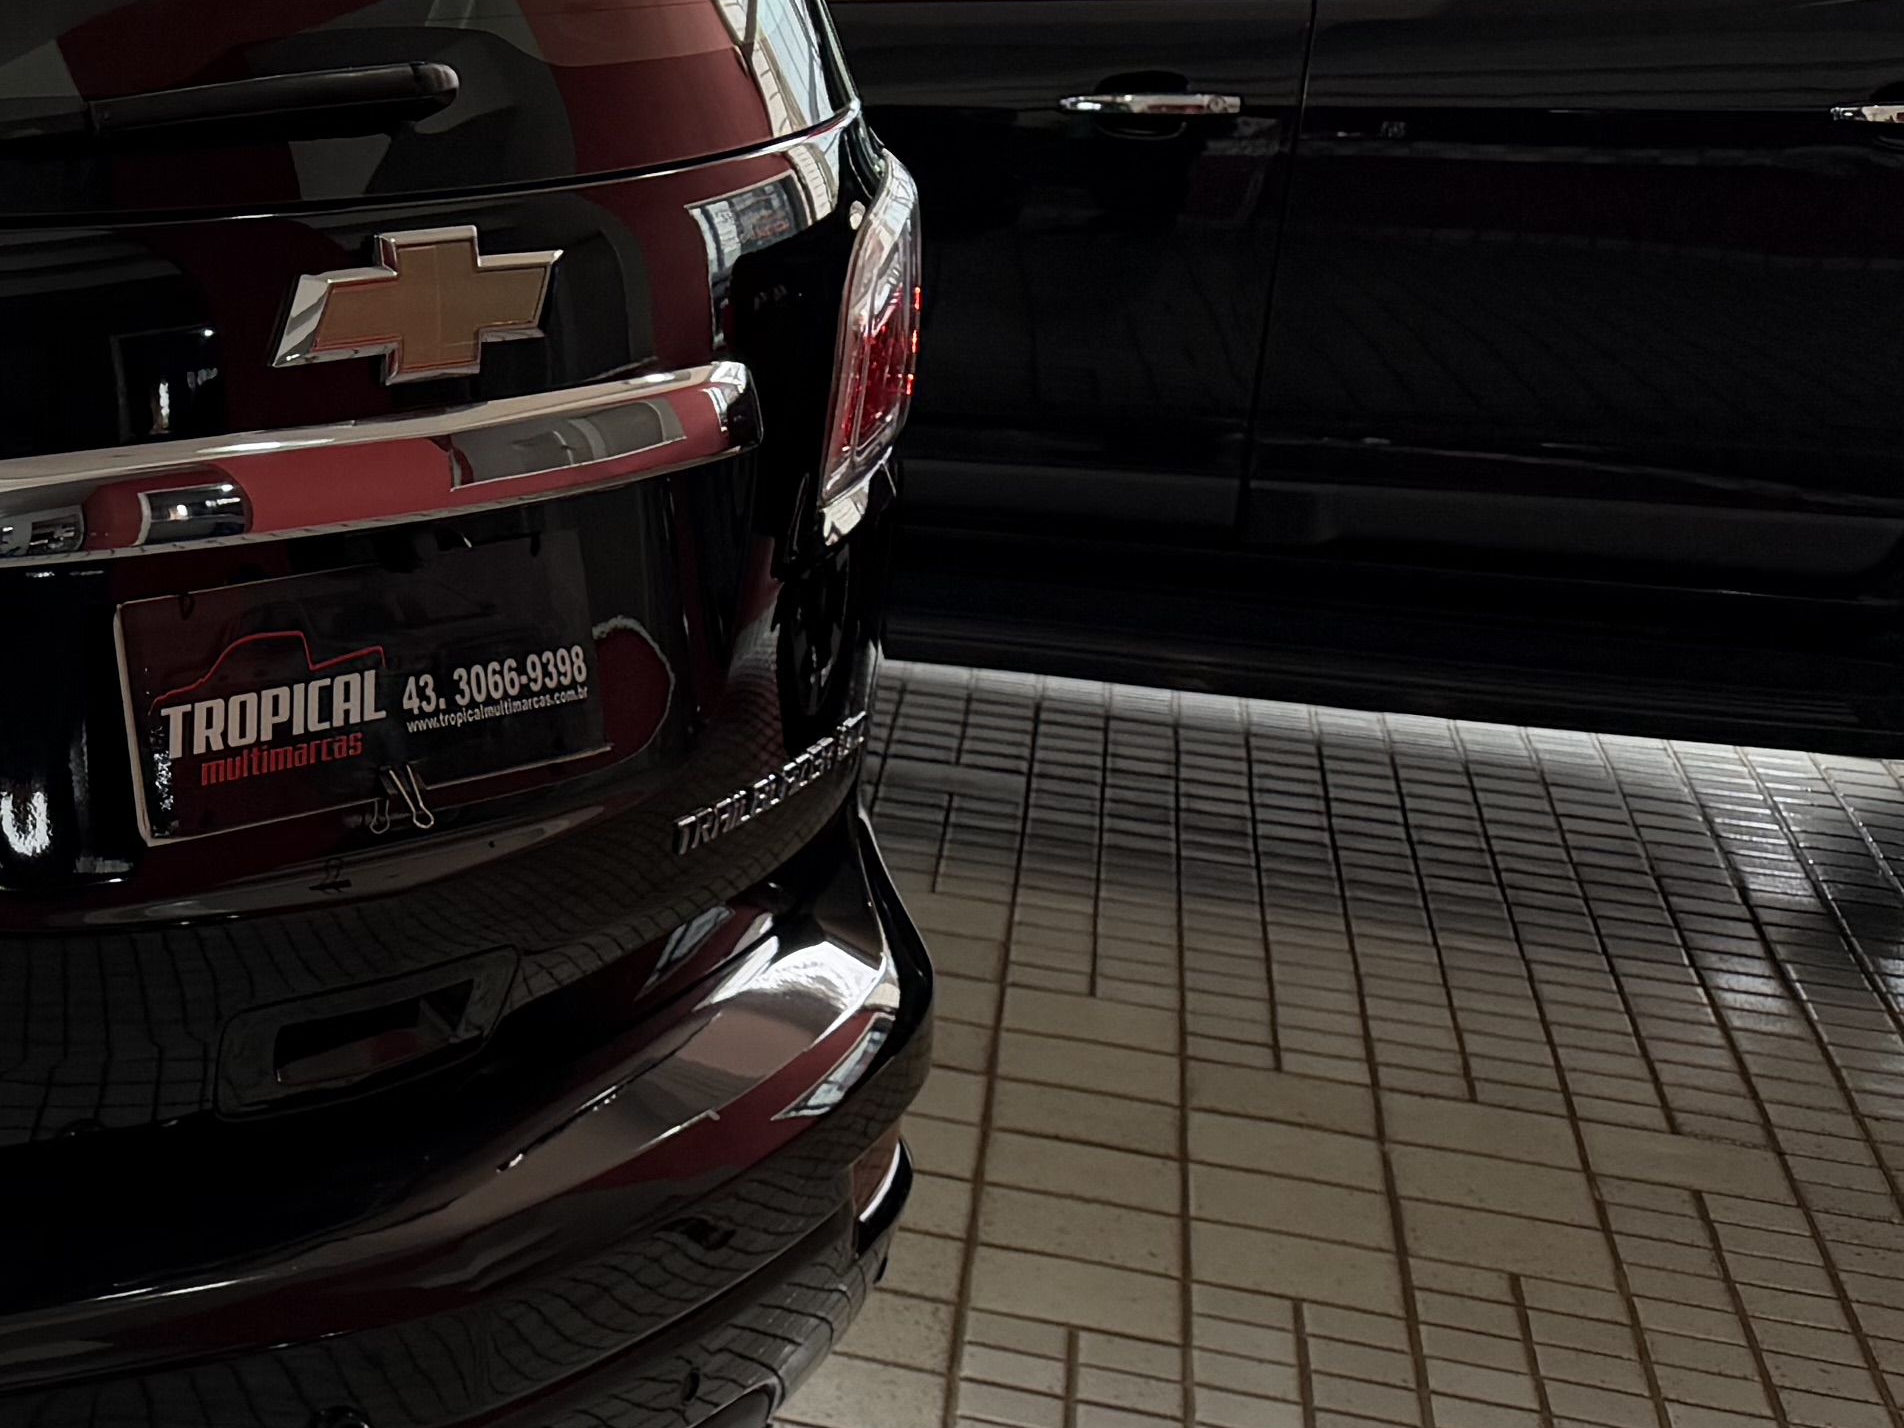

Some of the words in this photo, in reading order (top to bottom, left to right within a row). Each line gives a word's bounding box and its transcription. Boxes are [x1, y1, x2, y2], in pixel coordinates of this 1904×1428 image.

[455, 645, 588, 706] 3066-9398
[161, 669, 387, 760] TROPICAL
[405, 685, 589, 733] www.tropicalmultimarcas.com.br
[200, 731, 363, 786] multimarcas
